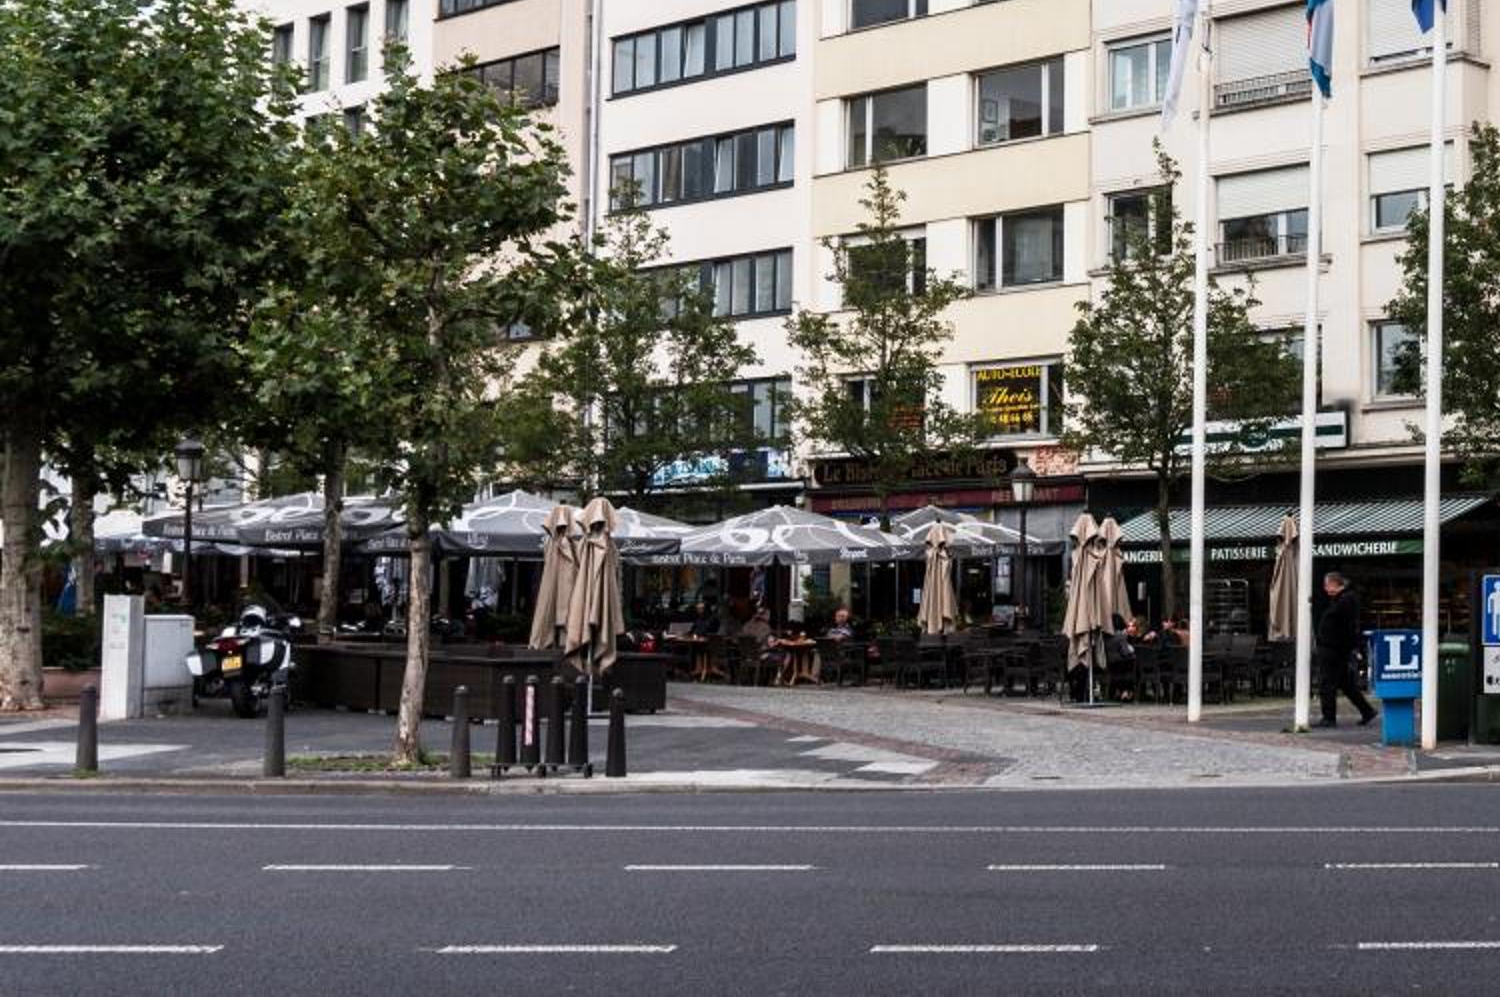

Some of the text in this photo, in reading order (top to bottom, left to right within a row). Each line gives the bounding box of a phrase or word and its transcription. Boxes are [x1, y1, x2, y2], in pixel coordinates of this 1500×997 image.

[1211, 545, 1268, 560] PATISSERIE
[1312, 540, 1398, 556] SANDWICHERIE
[1384, 634, 1420, 671] L'
